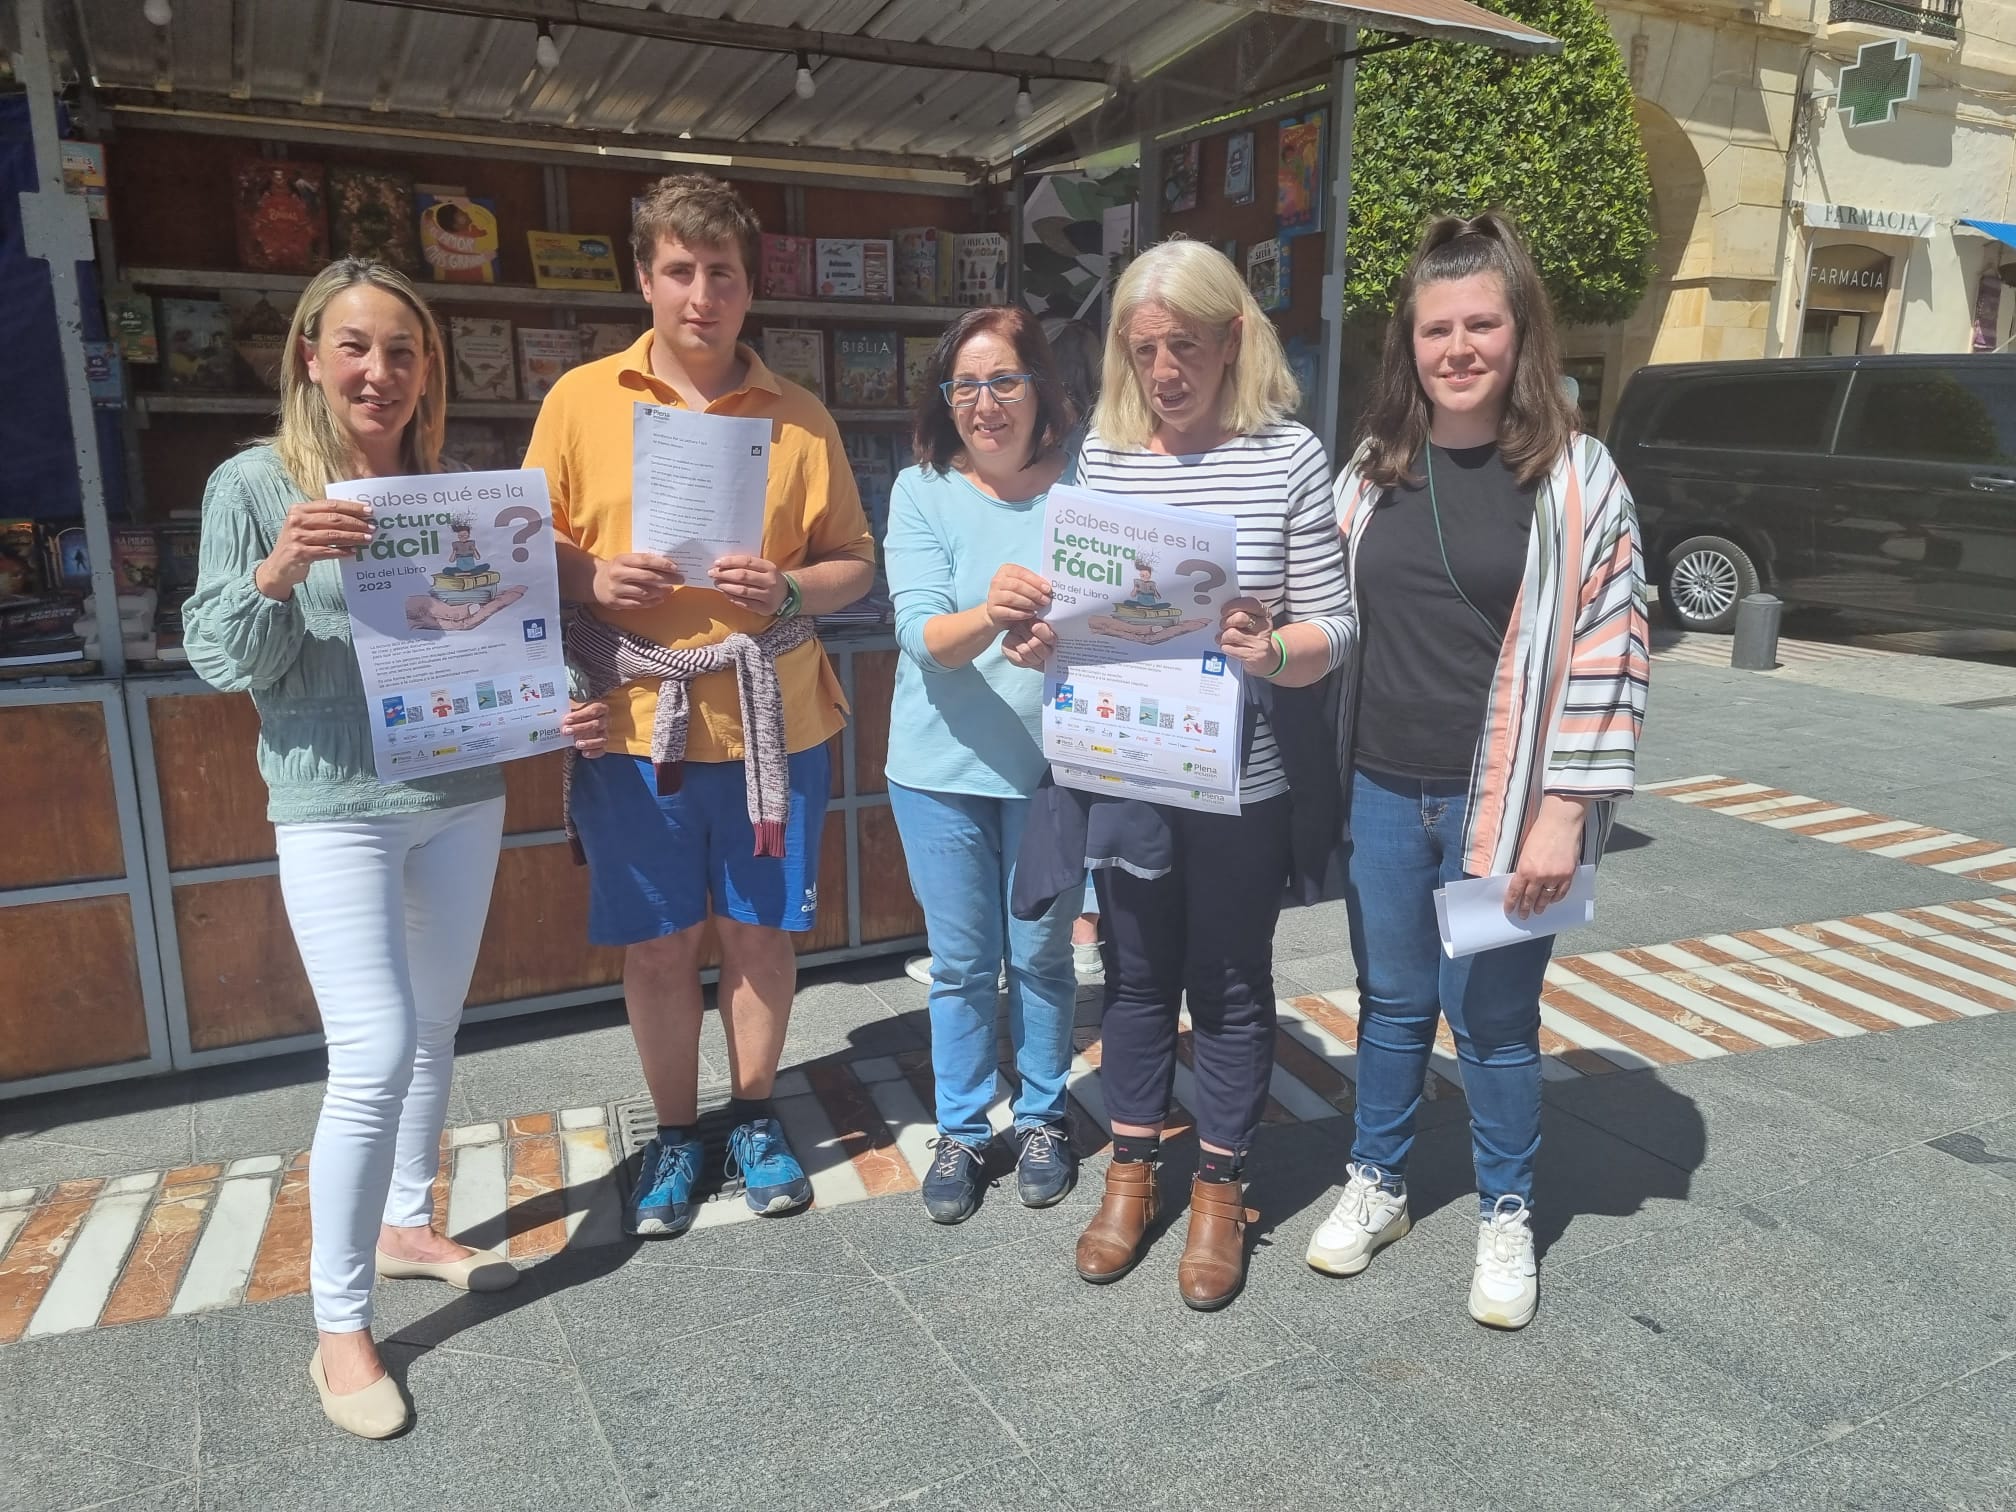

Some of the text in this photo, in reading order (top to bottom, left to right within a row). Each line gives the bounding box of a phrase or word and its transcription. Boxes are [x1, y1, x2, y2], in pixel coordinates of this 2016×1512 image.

[1825, 205, 1919, 232] FARMACIA
[1809, 266, 1884, 289] FARMACIA
[842, 341, 892, 354] BIBLIA
[350, 483, 524, 508] Sabes qué es la
[367, 511, 452, 530] ectura
[1055, 509, 1210, 552] ¿Sabes qué es la
[1053, 528, 1136, 561] Lectura
[378, 568, 395, 578] del
[397, 566, 427, 576] Libro
[1052, 549, 1123, 587] fácil
[359, 580, 392, 592] 2023
[1067, 585, 1082, 595] del
[1083, 588, 1109, 600] Libro
[1052, 591, 1077, 605] 2023
[539, 728, 560, 737] Plena
[1194, 763, 1217, 774] Plena
[1201, 791, 1225, 802] Plena
